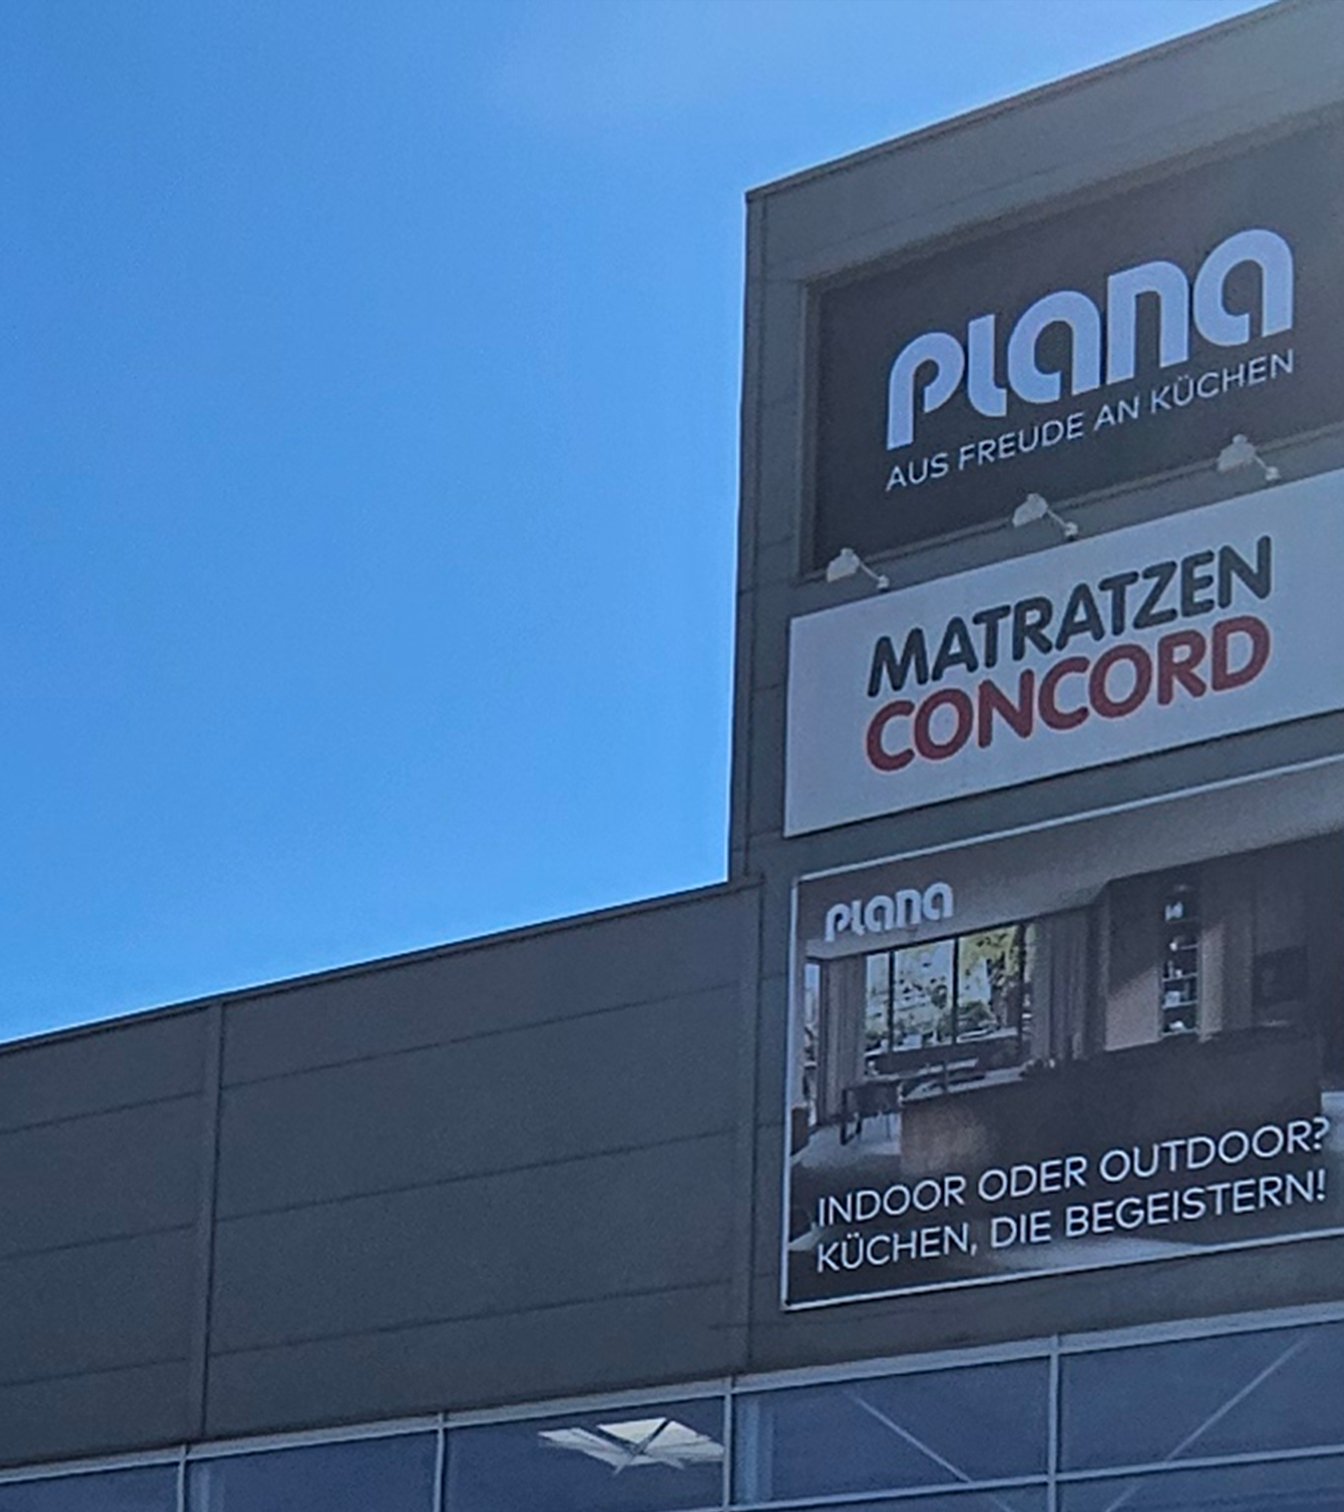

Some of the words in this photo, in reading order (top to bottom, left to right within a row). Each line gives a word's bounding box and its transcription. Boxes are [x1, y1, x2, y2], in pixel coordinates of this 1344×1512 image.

[885, 452, 949, 492] AUS
[958, 412, 1084, 471] FREUDE
[1093, 396, 1141, 433] AN
[1150, 348, 1295, 414] KÜCHEN
[867, 535, 1271, 698] MATRATZEN
[865, 614, 1270, 772] CONCORD
[816, 1222, 977, 1273] KÜCHEN,
[990, 1211, 1052, 1250] DIE
[1065, 1169, 1326, 1239] BEGEISTERN!
[818, 1176, 966, 1227] INDOOR
[978, 1156, 1087, 1201] ODER
[1099, 1117, 1330, 1183] OUTDOOR?
